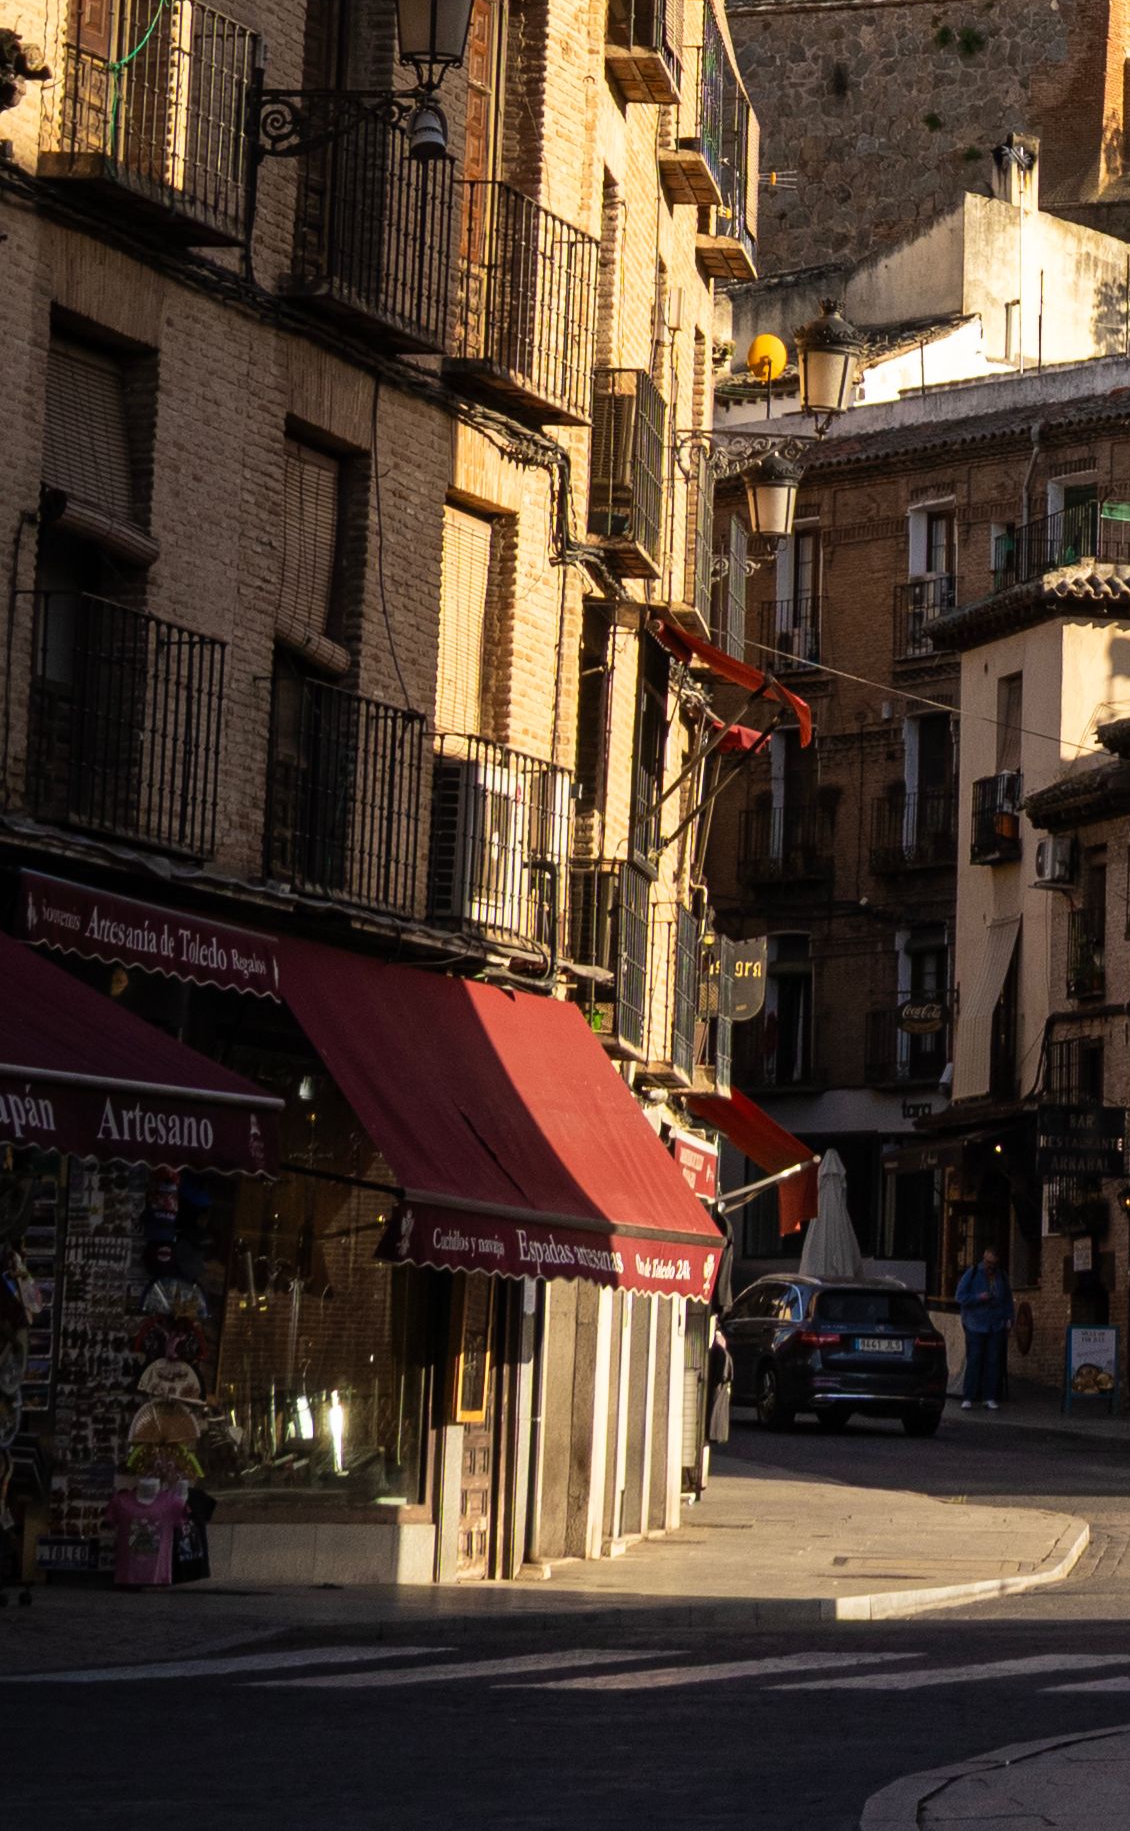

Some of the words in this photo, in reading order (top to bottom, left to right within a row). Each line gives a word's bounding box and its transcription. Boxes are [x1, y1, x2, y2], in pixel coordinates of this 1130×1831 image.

[85, 905, 158, 954] Artesanía
[160, 923, 175, 958] de
[178, 928, 228, 971] Toledo
[231, 948, 267, 978] Regalos
[97, 1096, 215, 1150] Artesano
[1069, 1113, 1096, 1130] BAR
[1040, 1134, 1123, 1152] RESTAURANTE
[1050, 1154, 1110, 1172] ARRABAL
[470, 1237, 477, 1257] y
[516, 1229, 575, 1274] Espadas
[574, 1245, 624, 1274] artesanas
[652, 1258, 675, 1279] Toledo
